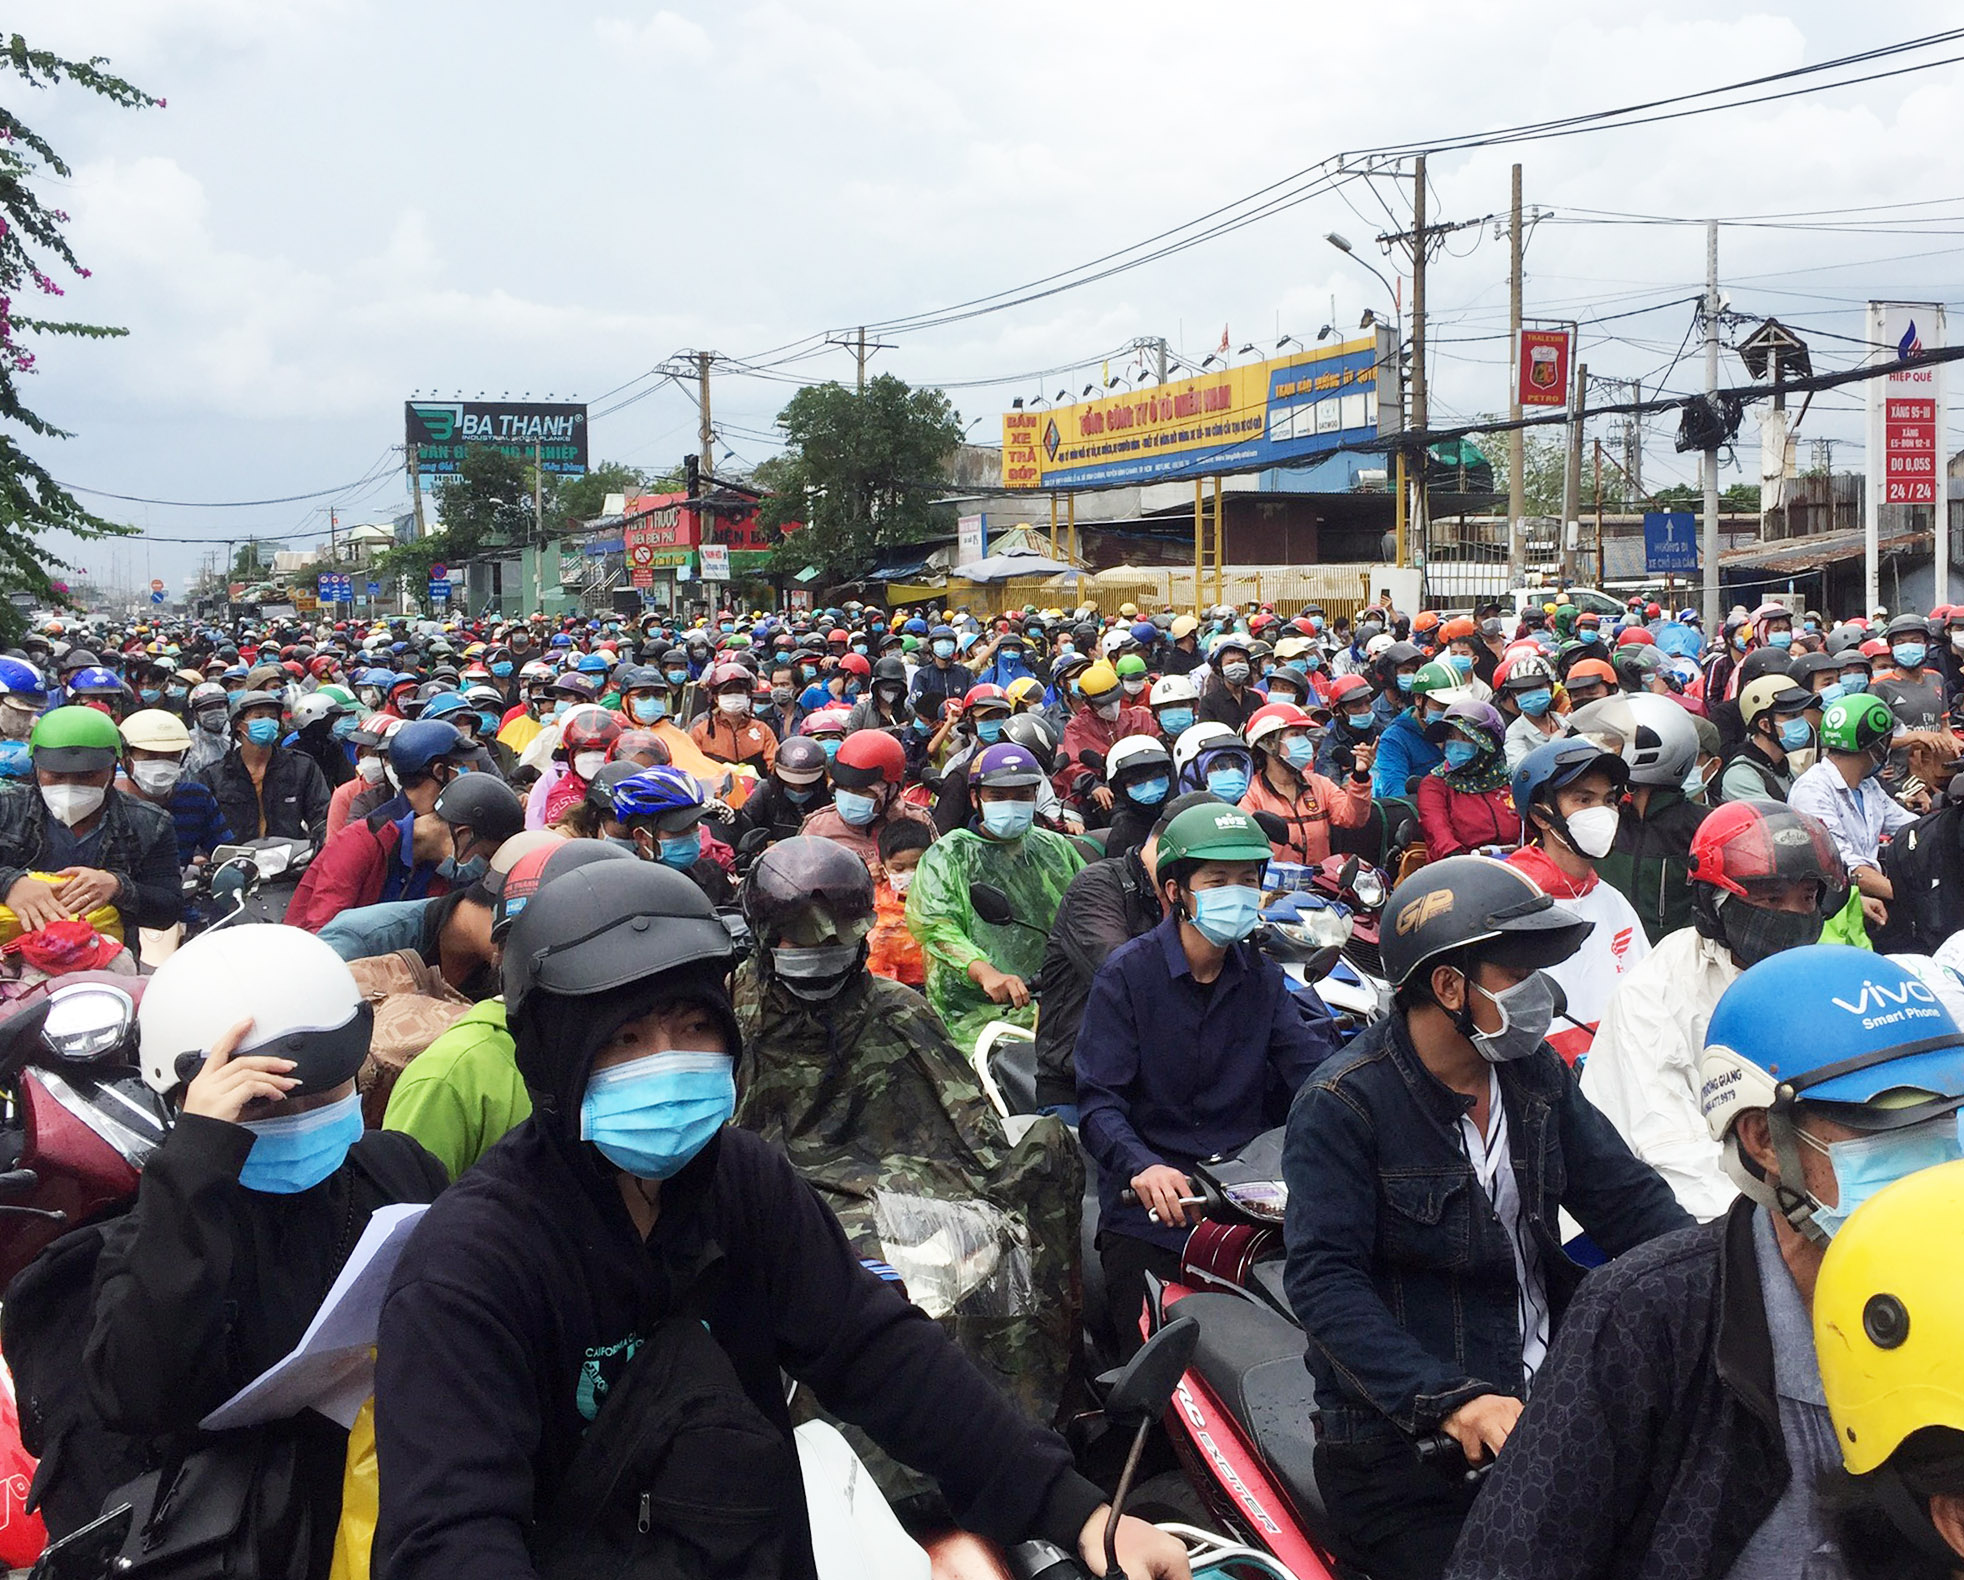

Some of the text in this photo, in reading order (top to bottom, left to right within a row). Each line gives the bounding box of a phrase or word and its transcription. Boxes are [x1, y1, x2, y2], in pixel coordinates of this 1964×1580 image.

[1891, 404, 1910, 419] XĂNG
[462, 414, 575, 437] BA THANH
[1006, 414, 1037, 428] BÁN
[1011, 433, 1032, 444] XE
[1902, 427, 1919, 437] XĂNG
[1008, 446, 1037, 463] TRẢ
[1905, 457, 1931, 472] 0,05S
[1890, 483, 1905, 499] 24
[1916, 483, 1931, 499] 24
[1831, 980, 1935, 1015] vivo
[1862, 1007, 1941, 1030] Smart Phone
[1718, 1068, 1742, 1087] GIANG
[1197, 1431, 1283, 1534] EXCITER
